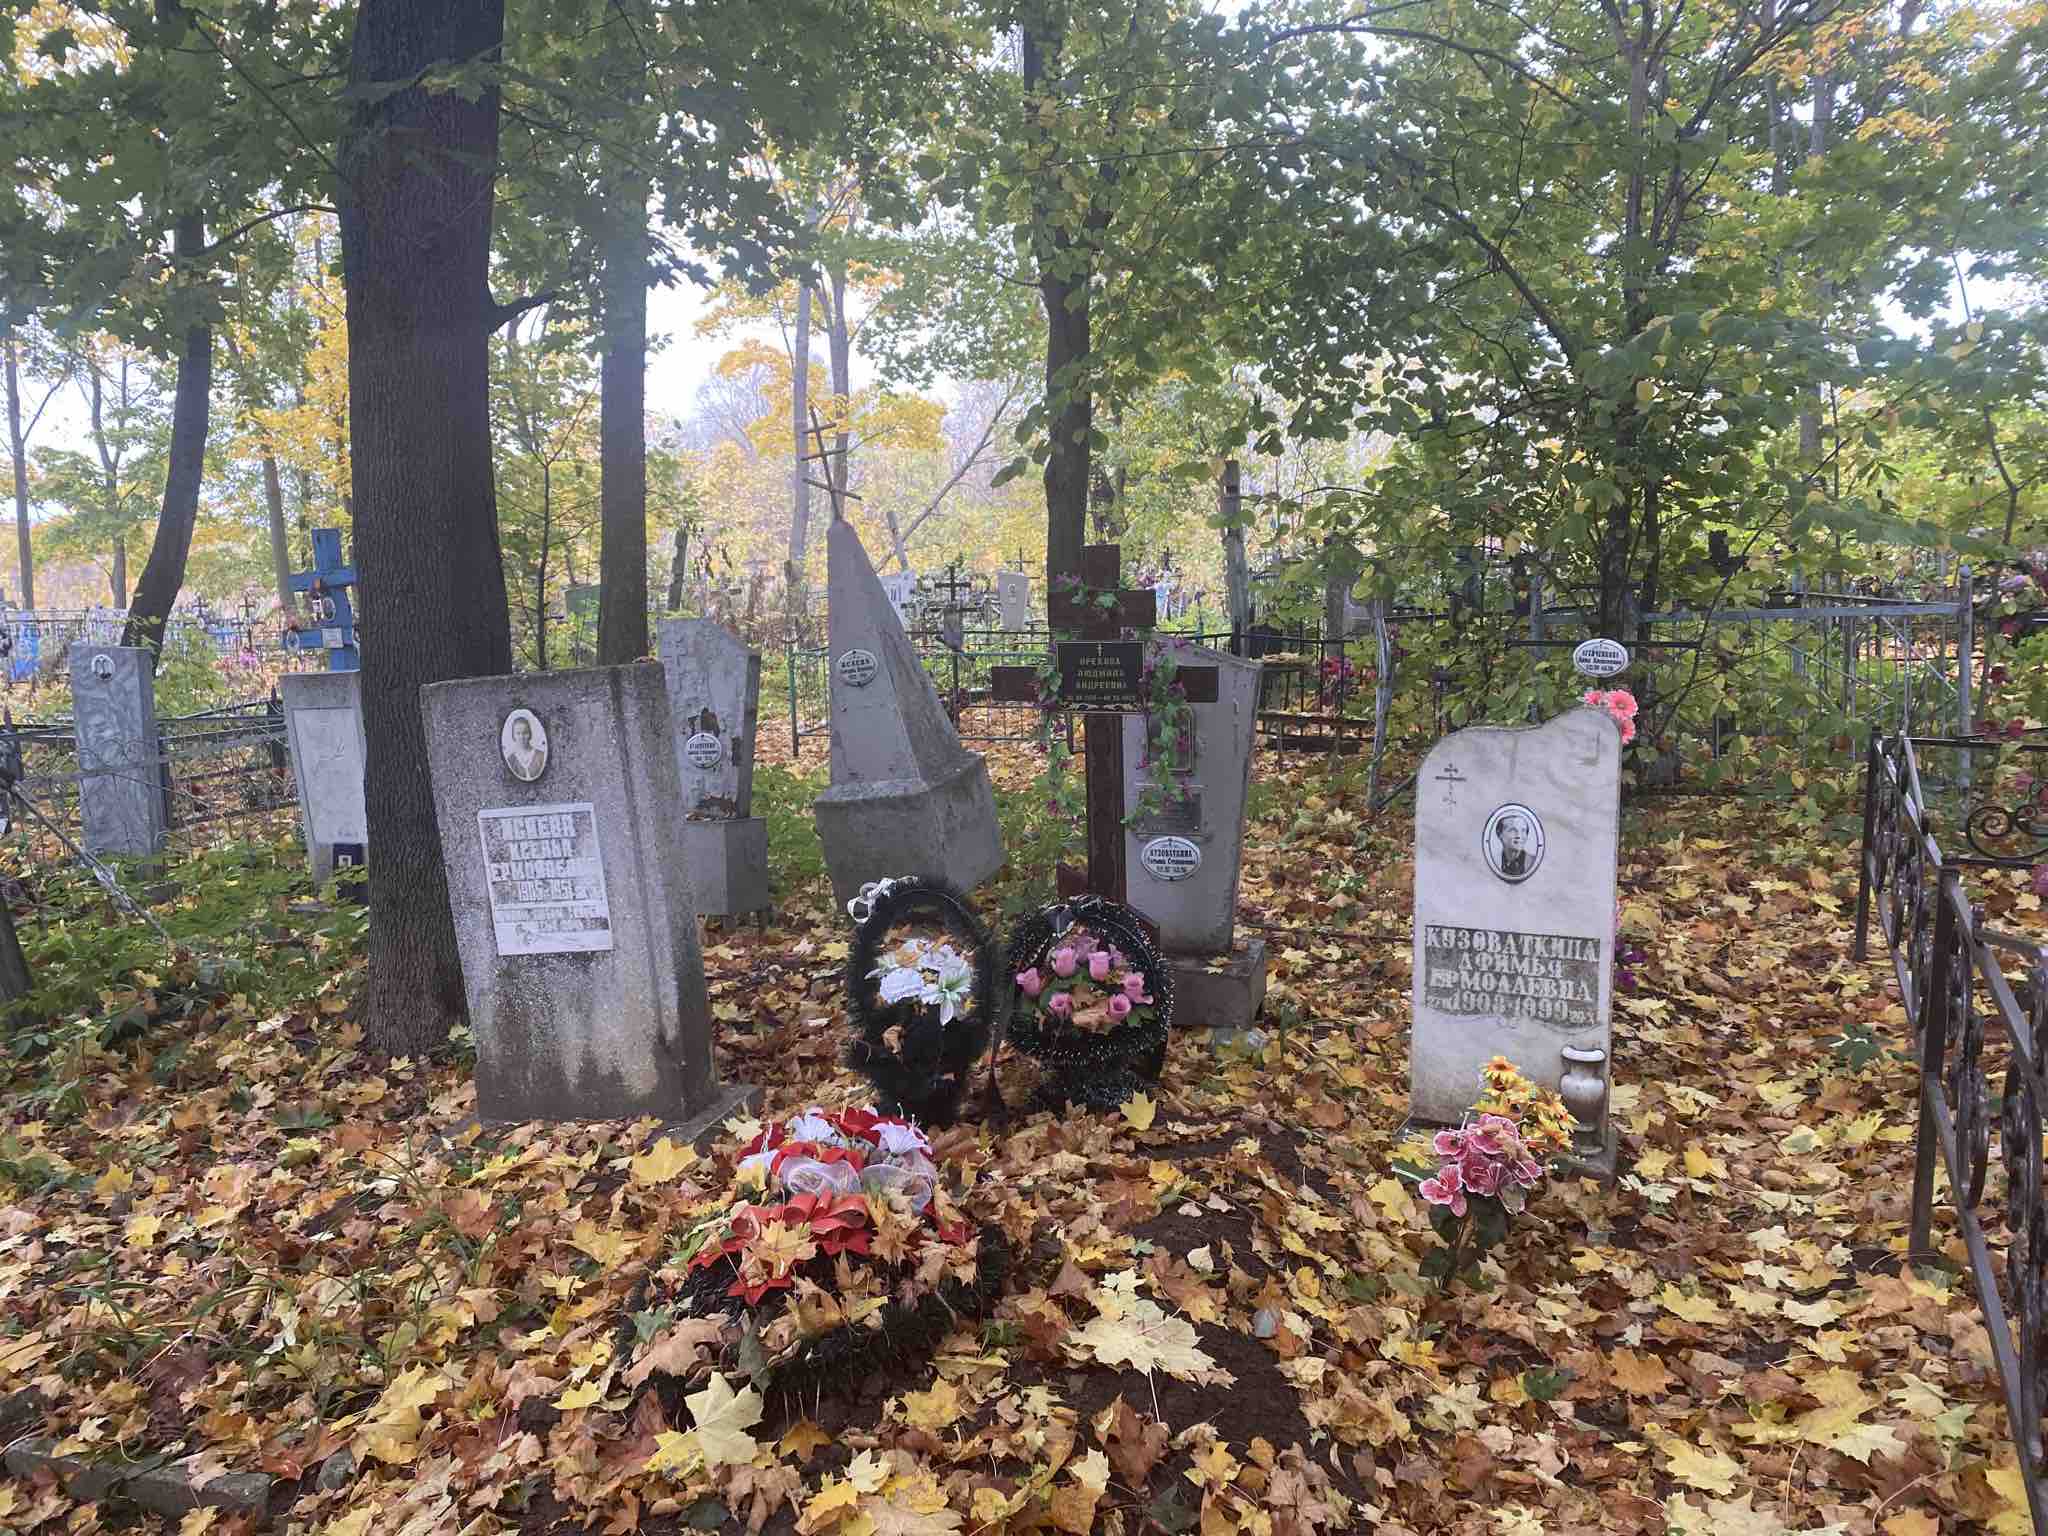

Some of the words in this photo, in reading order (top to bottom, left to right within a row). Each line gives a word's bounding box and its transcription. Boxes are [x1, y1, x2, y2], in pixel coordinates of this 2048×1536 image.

[1425, 926, 1600, 962] КУЗОВАТКИНА
[1458, 951, 1563, 978] АФИМЬЯ
[1429, 967, 1594, 1001] ЕРМОЛАЕВНА
